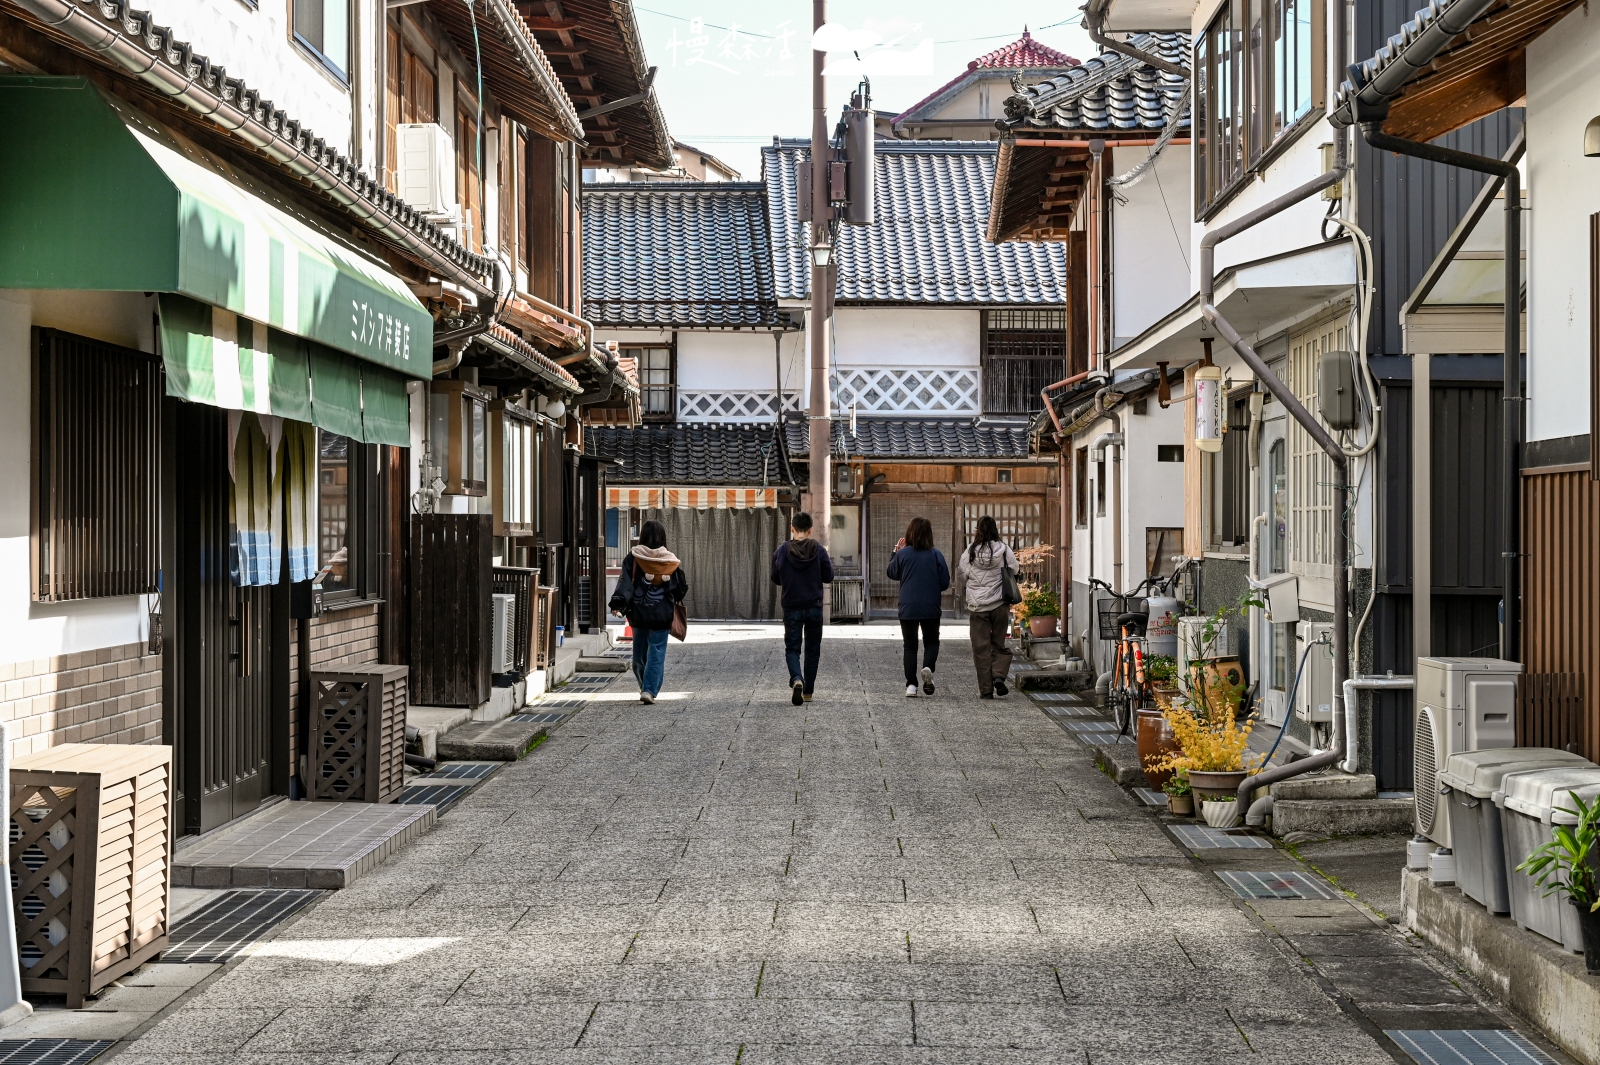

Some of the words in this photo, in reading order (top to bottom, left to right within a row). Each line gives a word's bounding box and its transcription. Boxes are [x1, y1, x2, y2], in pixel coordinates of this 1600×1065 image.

[351, 299, 411, 361] ミズシマ洋装店
